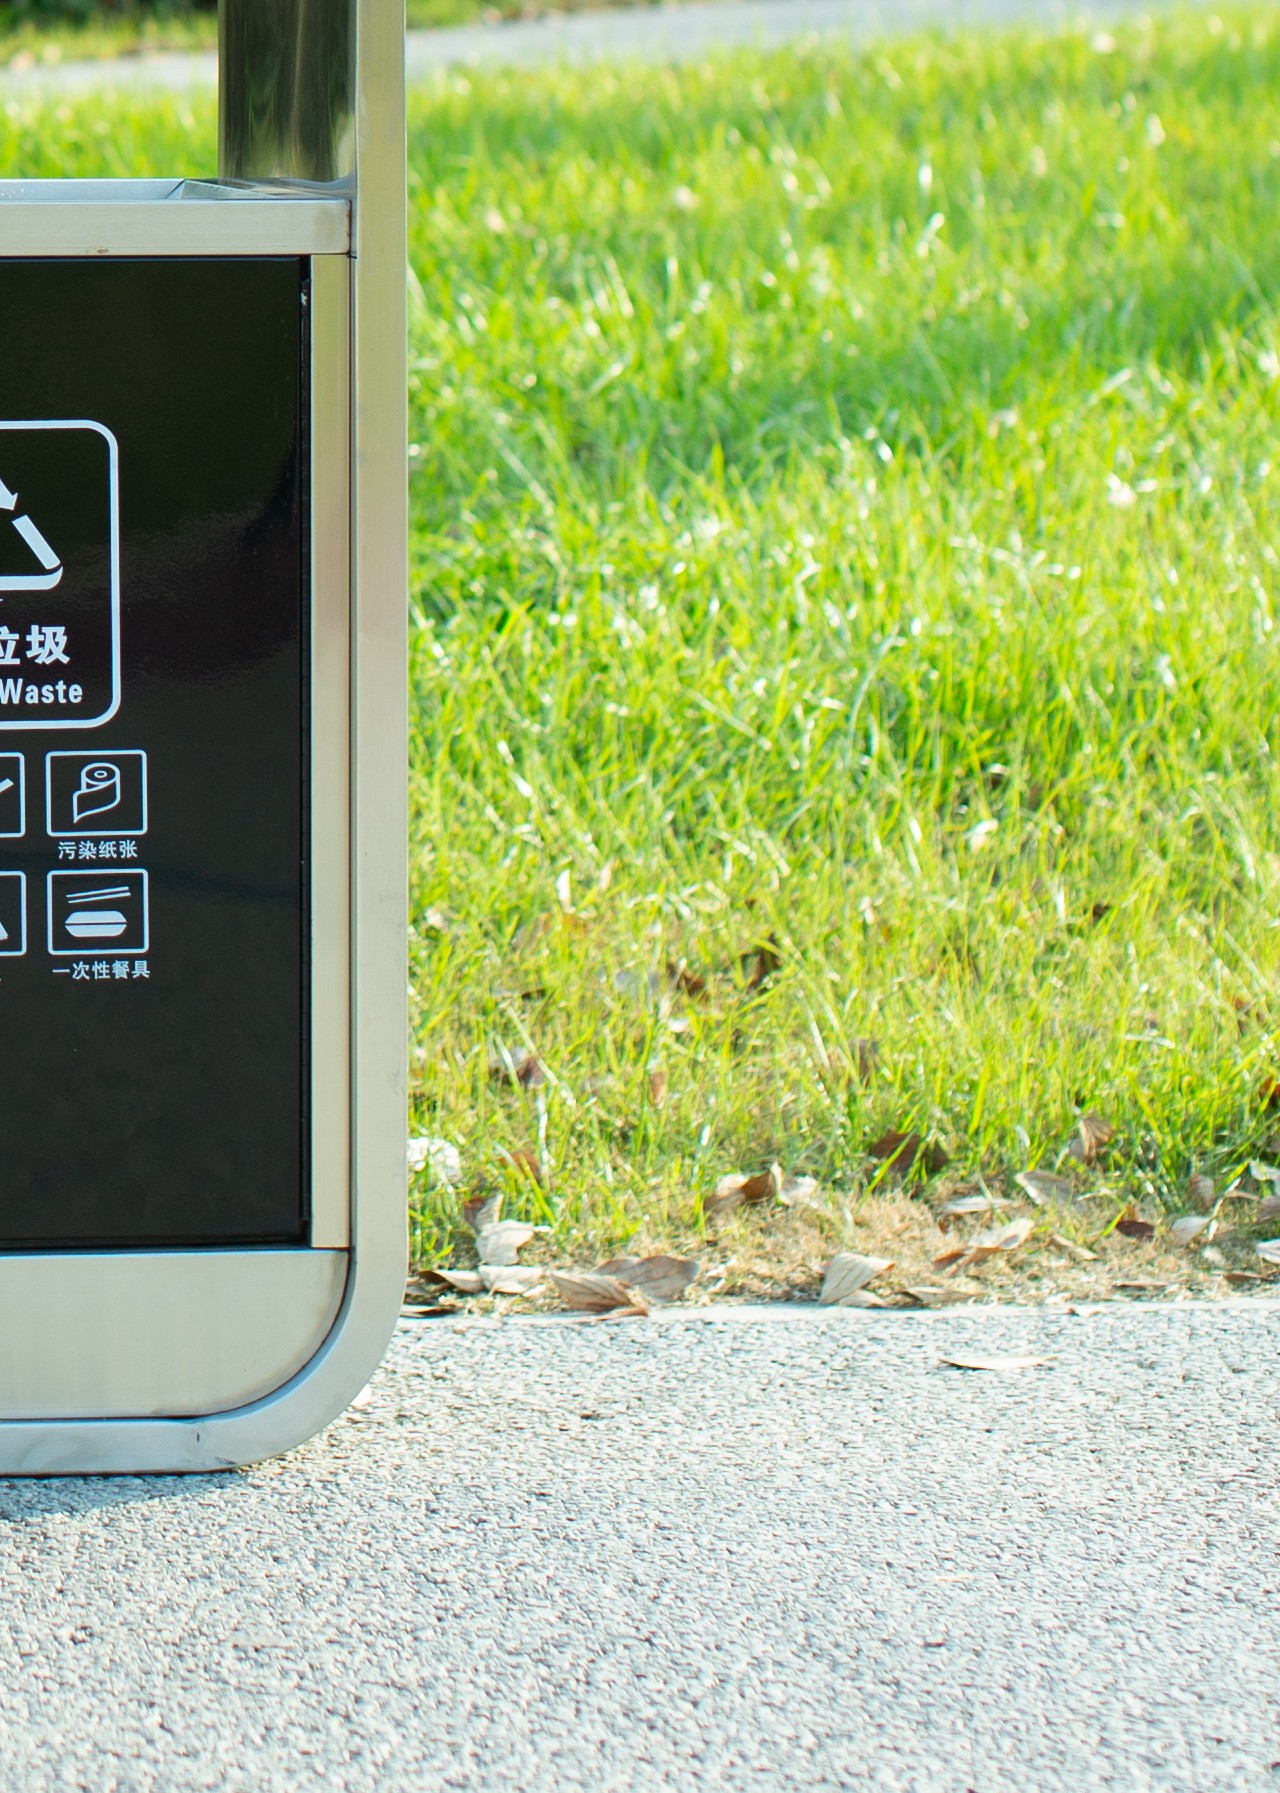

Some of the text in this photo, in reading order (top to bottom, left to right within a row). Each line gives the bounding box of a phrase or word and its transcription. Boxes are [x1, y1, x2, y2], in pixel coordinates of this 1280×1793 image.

[57, 840, 138, 859] 污染纸张
[52, 960, 151, 980] 一次性餐具
